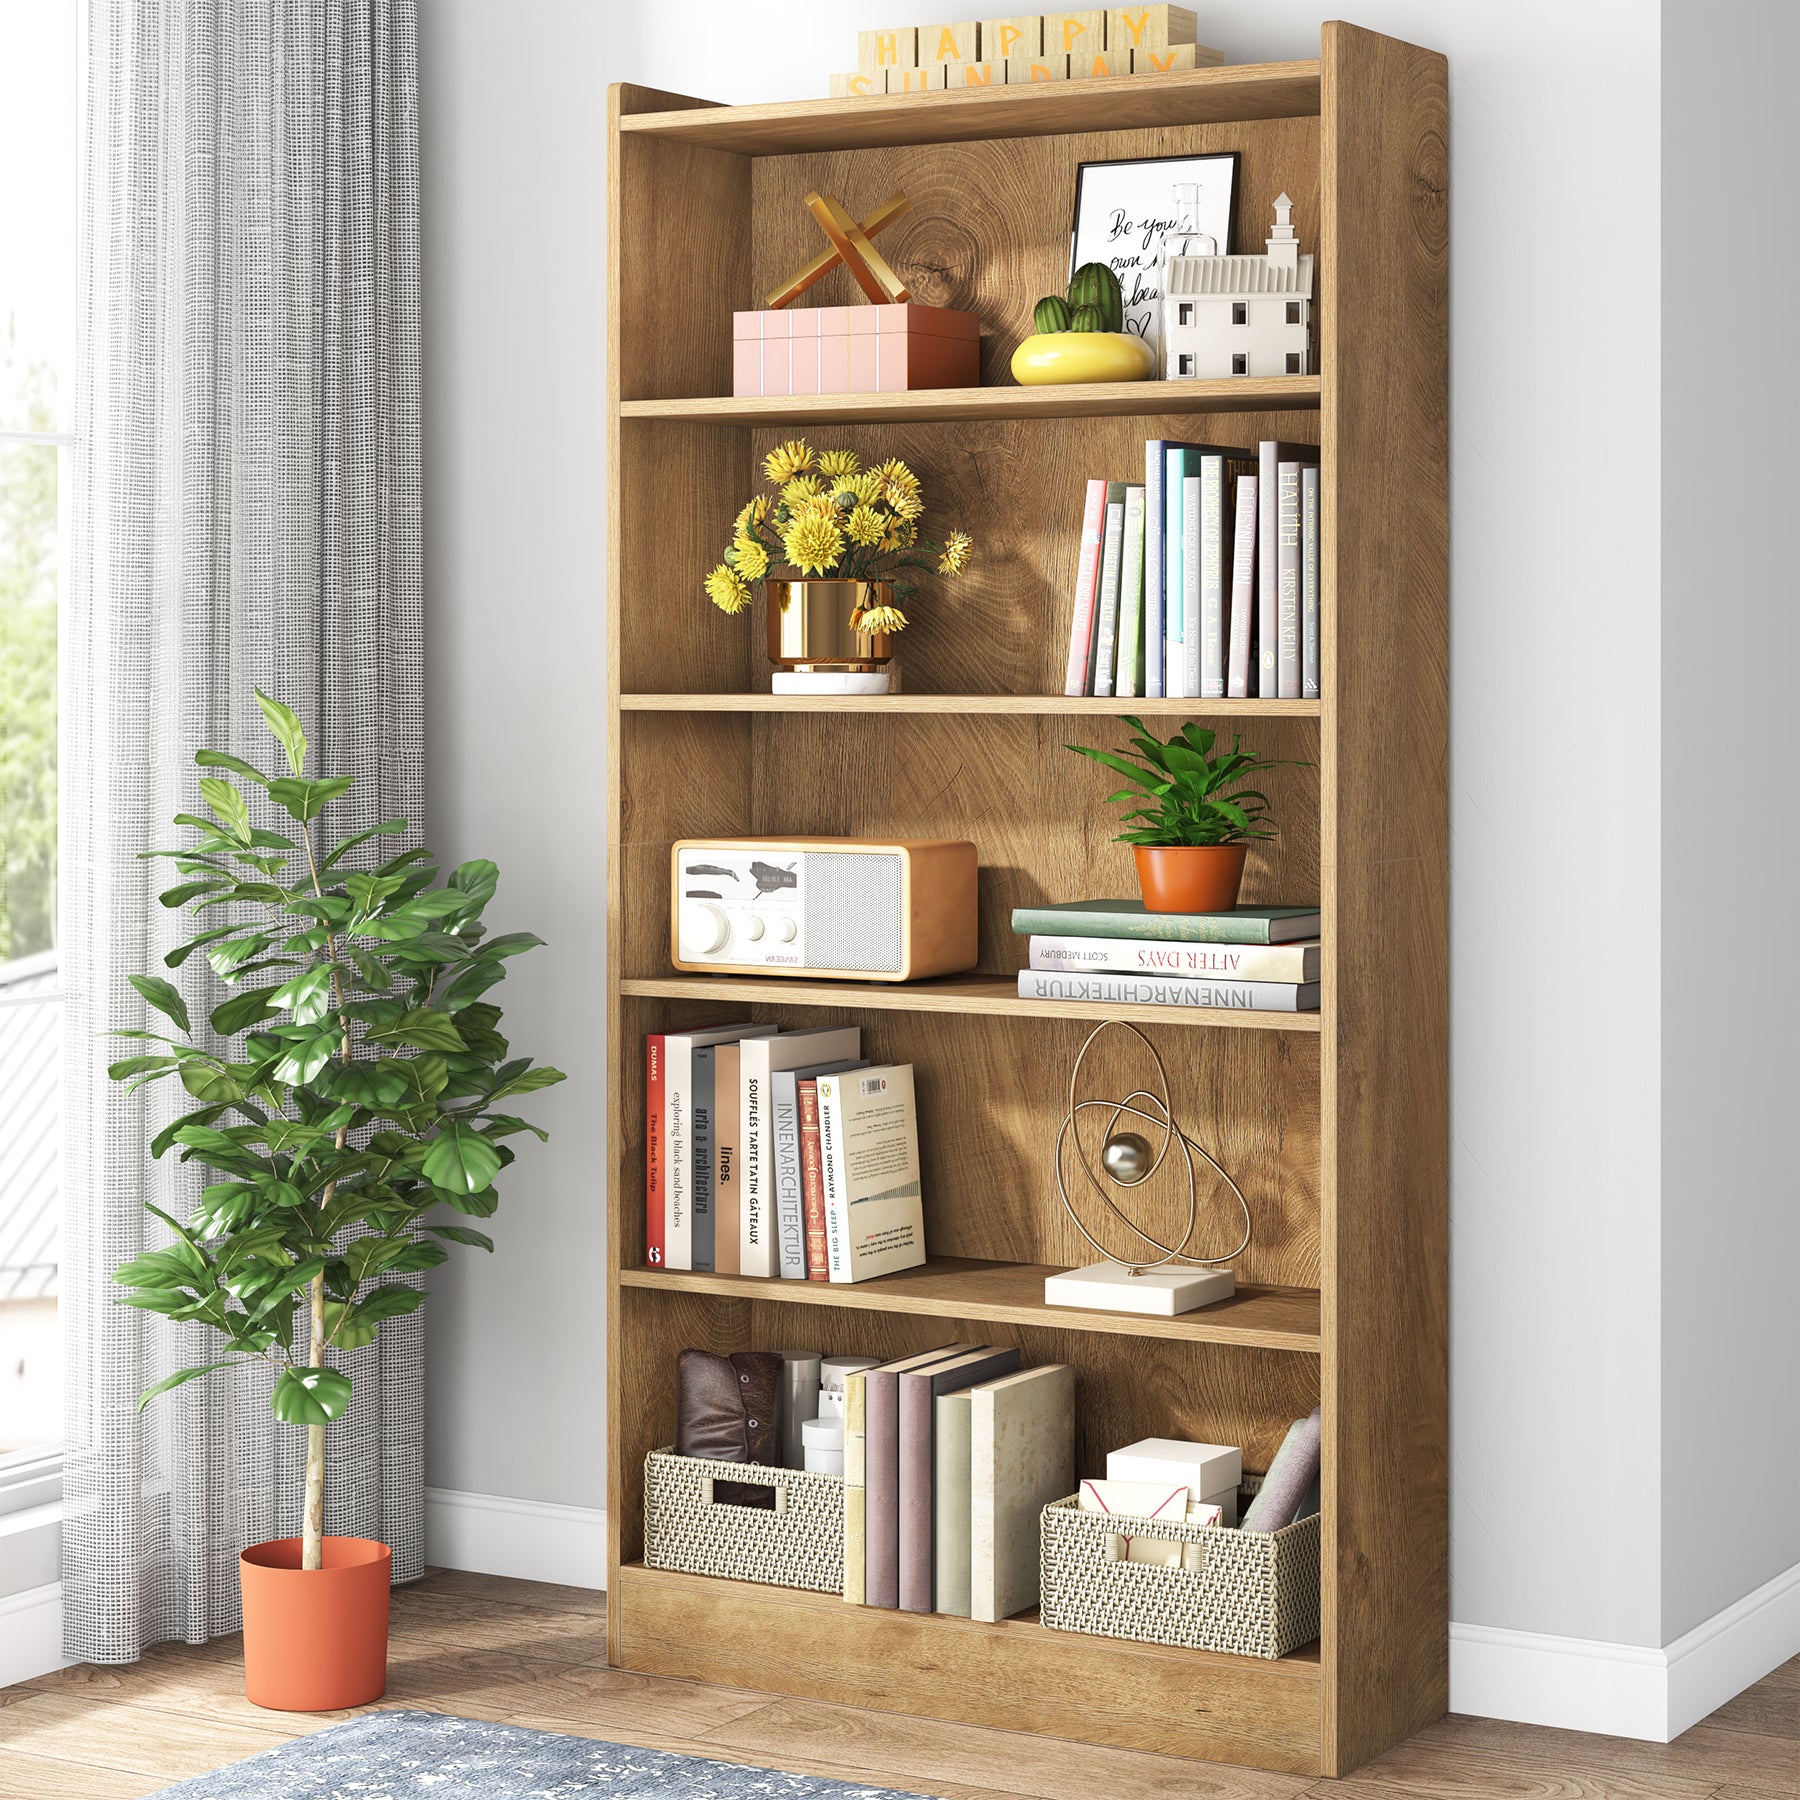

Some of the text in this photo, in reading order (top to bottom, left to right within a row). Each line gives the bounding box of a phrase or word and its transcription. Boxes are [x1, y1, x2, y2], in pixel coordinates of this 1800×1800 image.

[877, 13, 1149, 67] HAPPY
[1107, 208, 1133, 242] Be
[1110, 256, 1143, 272] own
[1308, 487, 1314, 496] ON
[1204, 460, 1219, 589] THE PROPHECY OF ZEPHYRUS
[1236, 487, 1255, 585] GEOSYNCHRON
[1106, 535, 1119, 578] DUNGEON
[1308, 564, 1314, 572] OF
[1104, 580, 1116, 592] OF
[1102, 594, 1116, 622] DEATH
[1282, 568, 1296, 662] KIRSTEN KELLY
[1040, 950, 1108, 962] SCOTT MEDBURY
[1138, 950, 1240, 971] AFTER DAYS
[1036, 978, 1253, 1008] INNENARCHITEKTUR
[695, 1108, 709, 1130] arts
[823, 1105, 832, 1150] CHANDLER
[670, 1092, 684, 1228] exploring black sand beaches
[720, 1146, 733, 1186] lines.
[749, 1078, 760, 1245] SOUFFLÉS TARTE TATIN GÂTEAUX
[807, 1140, 818, 1172] JOURNEY
[826, 1153, 835, 1198] RAYMOND
[695, 1148, 710, 1214] architecture
[777, 1103, 800, 1266] INNENARCHITEKTUR
[809, 1172, 819, 1218] UNEXPECTED
